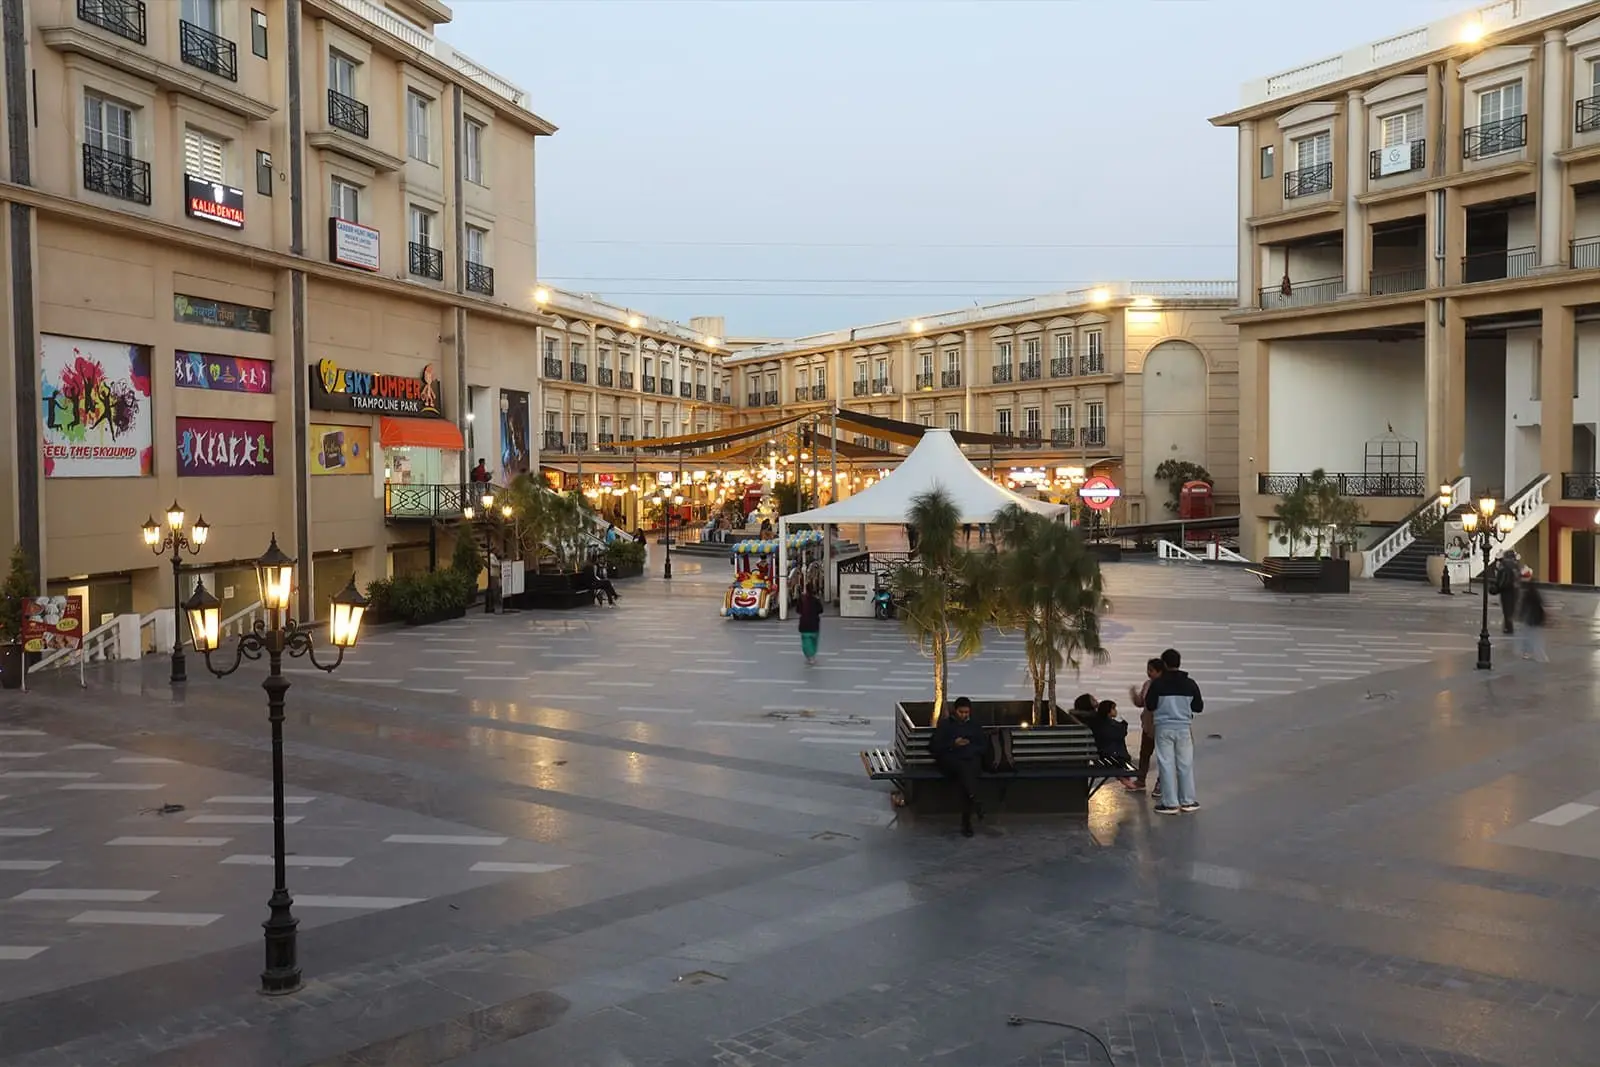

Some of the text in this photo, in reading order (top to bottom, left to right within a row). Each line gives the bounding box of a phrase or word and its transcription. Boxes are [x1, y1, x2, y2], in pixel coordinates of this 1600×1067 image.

[192, 198, 216, 215] KALIA
[216, 204, 244, 222] DENTAL
[345, 370, 420, 400] SKY JUMPER
[352, 396, 418, 412] TRAMPOLINE PARK
[69, 446, 91, 458] THE
[92, 446, 137, 459] SKYJUMP
